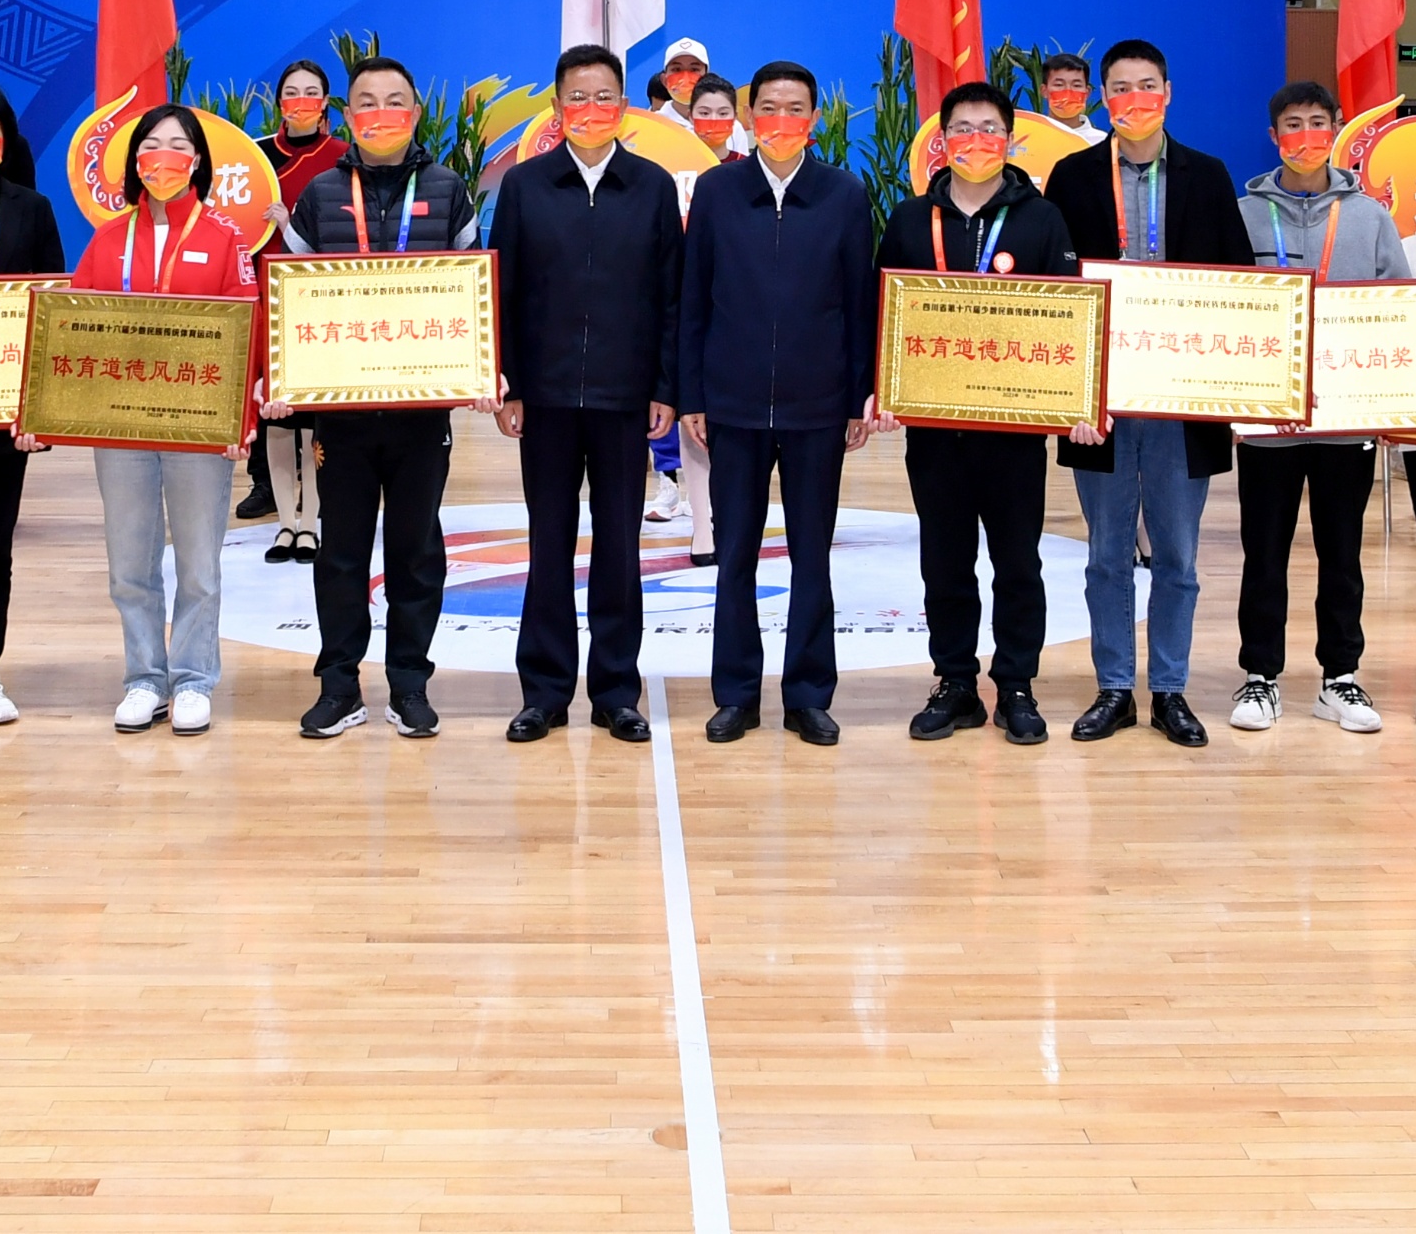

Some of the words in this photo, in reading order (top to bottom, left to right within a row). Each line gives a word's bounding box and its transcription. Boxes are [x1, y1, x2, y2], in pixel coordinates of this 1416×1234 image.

[295, 317, 469, 345] 体育道德风尚奖
[1110, 329, 1283, 358] 体育道德风尚奖
[905, 334, 1076, 366] 体育道德风尚奖
[52, 354, 222, 386] 体育道德风尚奖
